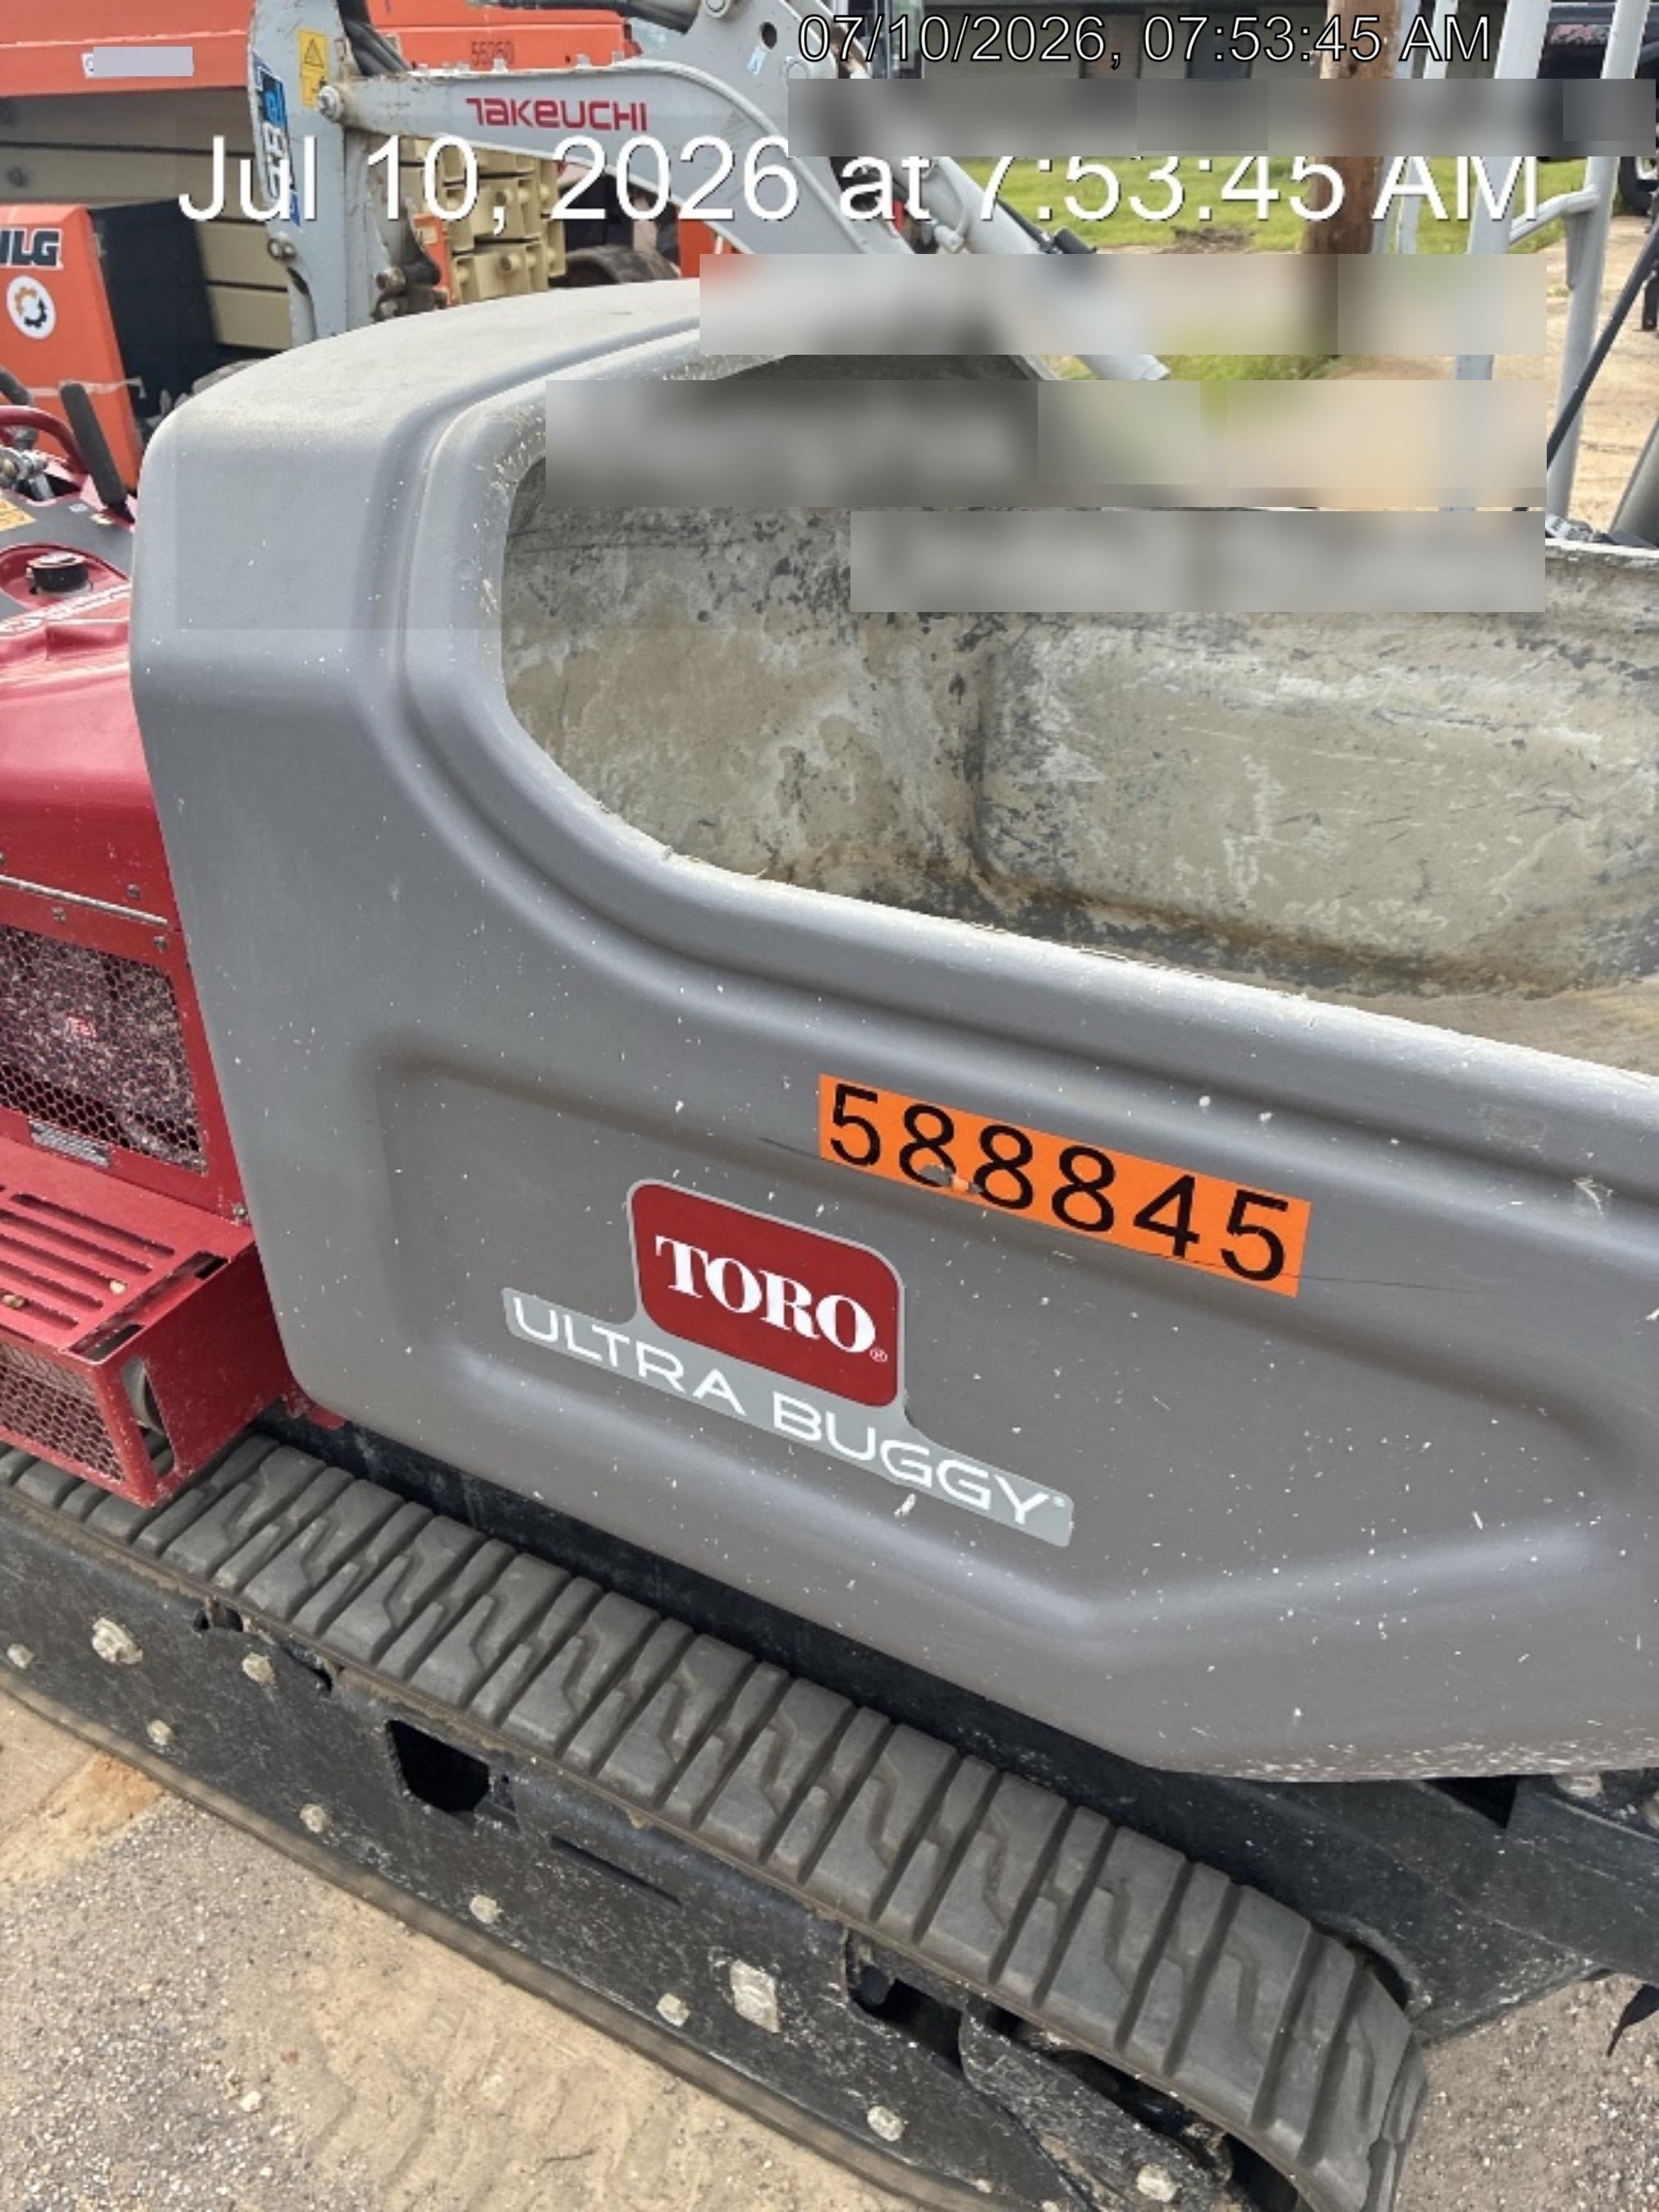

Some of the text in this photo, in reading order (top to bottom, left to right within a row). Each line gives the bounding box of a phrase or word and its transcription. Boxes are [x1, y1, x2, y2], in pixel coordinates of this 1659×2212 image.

[830, 1083, 1290, 1282] 588845
[512, 1296, 1049, 1525] ULTRA BUGGY
